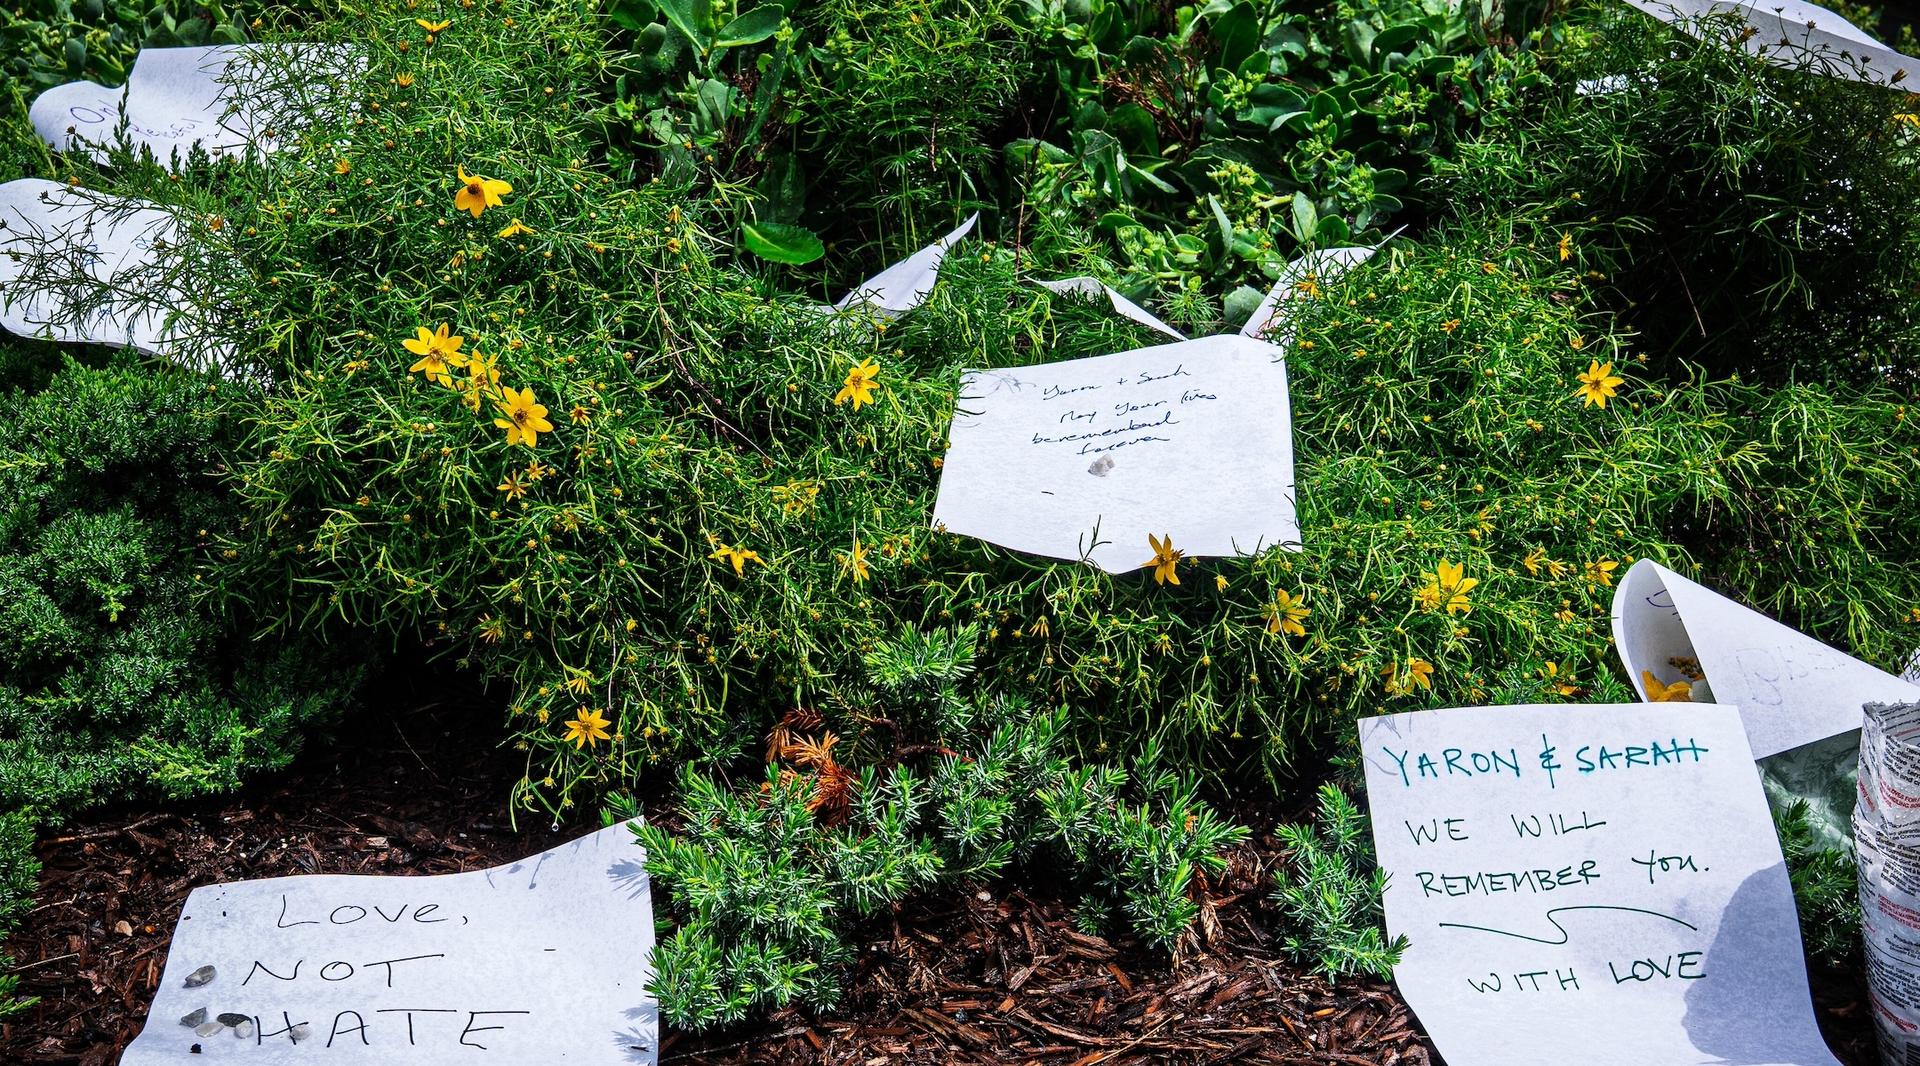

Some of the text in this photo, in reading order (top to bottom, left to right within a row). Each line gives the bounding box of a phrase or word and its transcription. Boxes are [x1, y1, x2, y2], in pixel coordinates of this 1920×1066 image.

[1059, 410, 1097, 424] May
[1382, 733, 1710, 789] YARON & SARAH
[1404, 811, 1607, 845] WE WILL
[1415, 860, 1601, 898] REMEMBER
[241, 952, 446, 989] NOT
[1467, 951, 1707, 994] WITH LOVE
[254, 1009, 531, 1051] HATE
